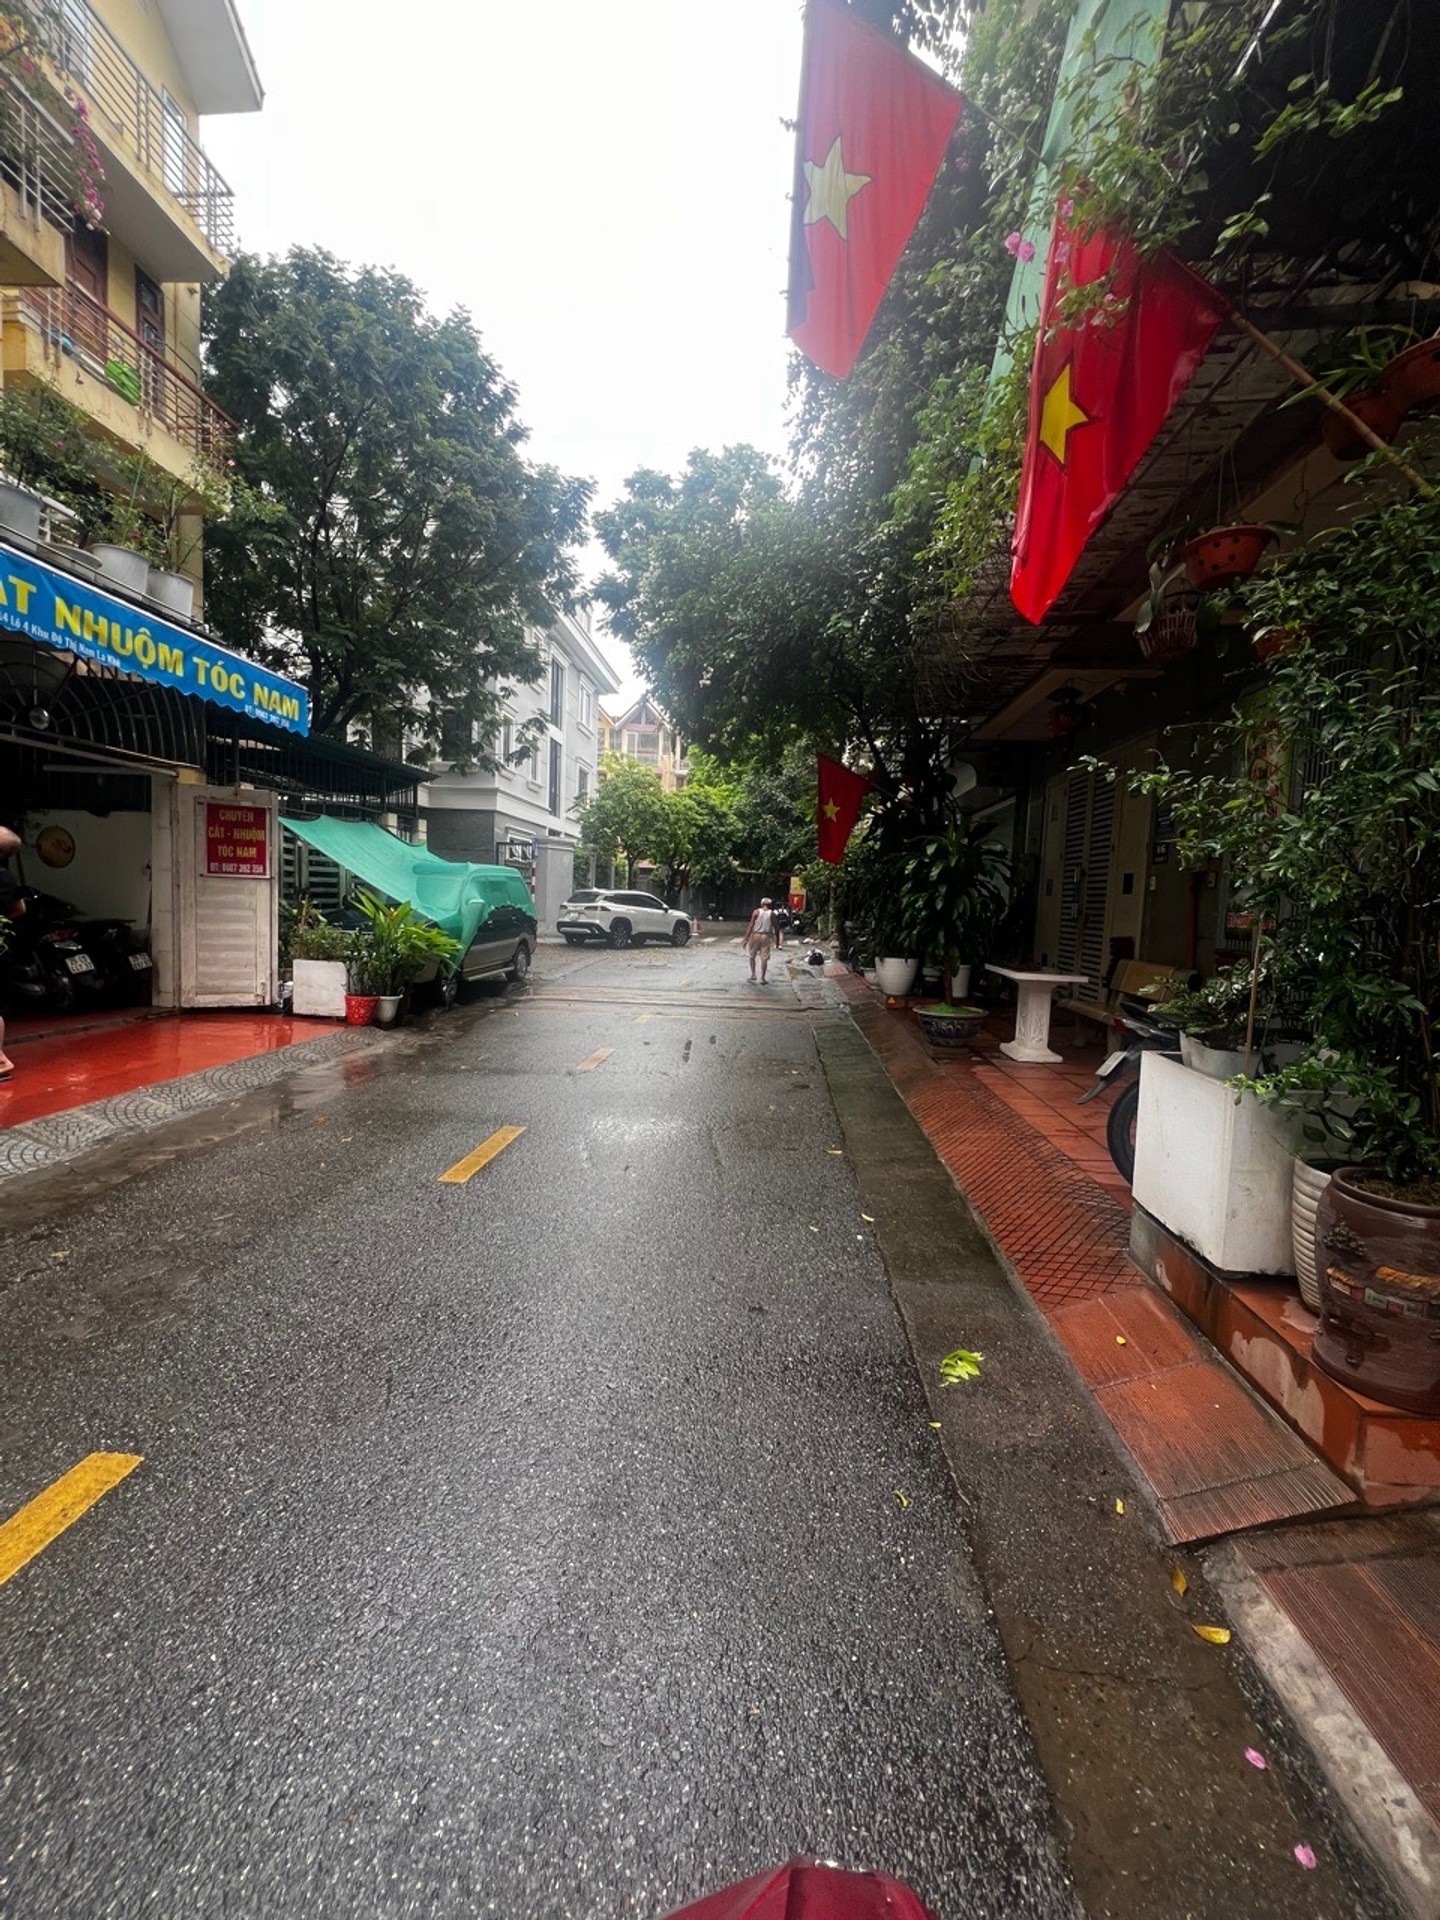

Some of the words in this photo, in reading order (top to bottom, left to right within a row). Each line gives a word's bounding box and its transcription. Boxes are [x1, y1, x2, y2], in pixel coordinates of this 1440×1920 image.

[31, 623, 50, 639] Khu
[55, 596, 184, 677] NHUỘM
[192, 656, 246, 699] TÓC
[253, 683, 299, 721] NAM
[219, 808, 254, 822] CHUYÊN
[208, 823, 225, 838] CẮT
[233, 827, 265, 843] NHUỘM
[218, 844, 234, 857] TÓC
[236, 846, 257, 858] NAM
